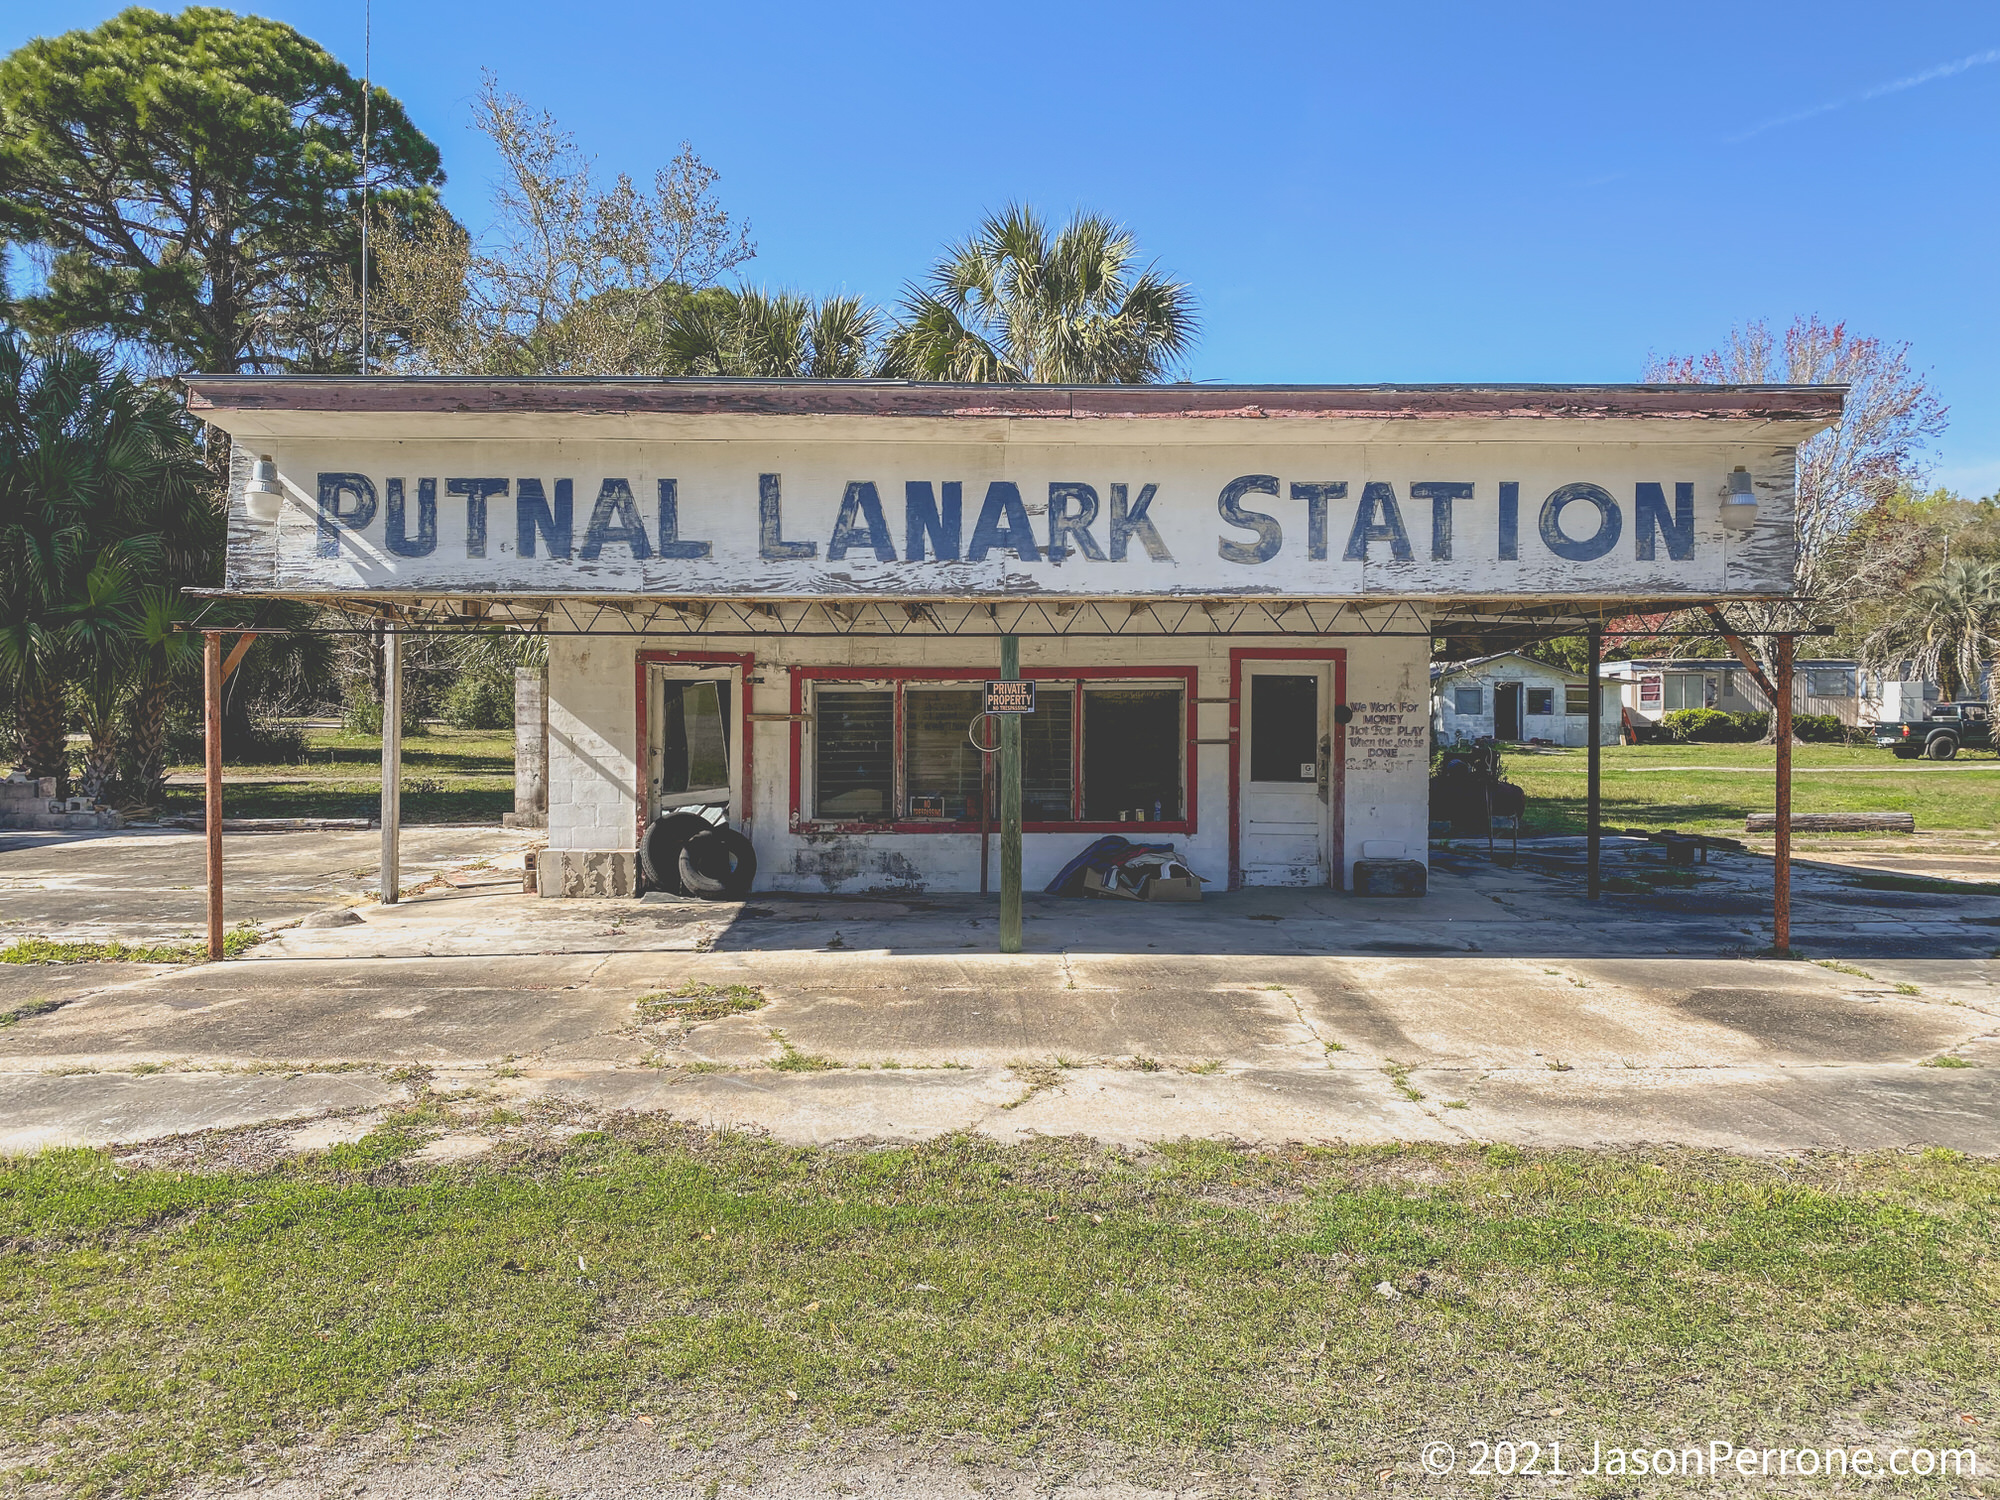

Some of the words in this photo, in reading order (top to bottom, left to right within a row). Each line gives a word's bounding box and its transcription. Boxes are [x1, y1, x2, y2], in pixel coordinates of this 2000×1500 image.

[315, 472, 713, 560] PUTNAL
[758, 472, 1176, 563] LANARK
[1217, 474, 1695, 566] STATION
[993, 683, 1027, 694] PRIVATE
[987, 694, 1031, 705] PROPERTY
[1349, 702, 1367, 713] We
[1370, 702, 1396, 713] Work
[1400, 702, 1419, 713] For
[1363, 715, 1404, 725] MONEY
[1371, 725, 1393, 736] For
[1397, 726, 1425, 736] PLAY
[1347, 736, 1376, 748] When
[1377, 737, 1393, 747] the
[1394, 737, 1412, 748] Job
[1367, 748, 1398, 758] DONE
[923, 799, 931, 808] NO
